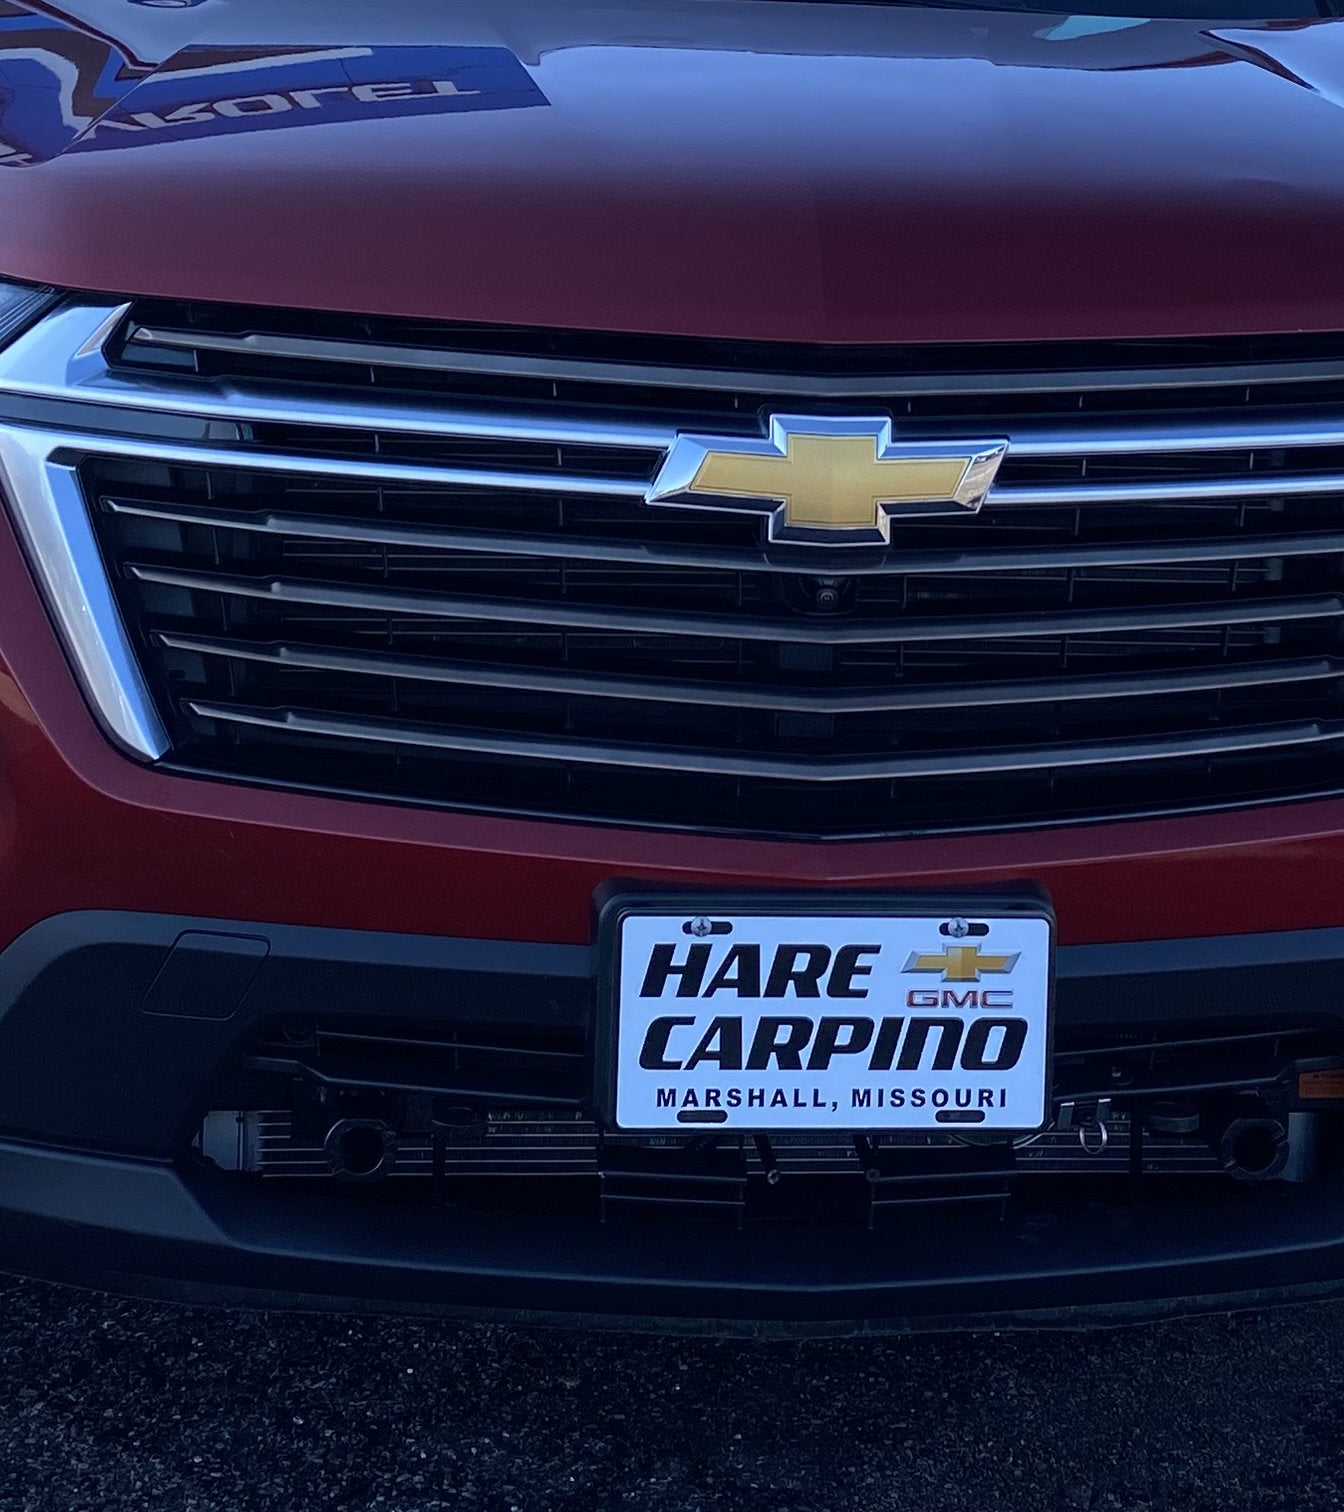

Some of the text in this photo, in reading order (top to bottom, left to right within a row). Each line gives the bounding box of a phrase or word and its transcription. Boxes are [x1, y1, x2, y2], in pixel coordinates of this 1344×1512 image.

[639, 943, 882, 998] HARE
[906, 988, 1015, 1009] GMC
[639, 1016, 1029, 1071] CARPINO
[656, 1088, 1007, 1112] MARSHALL, MISSOURI
